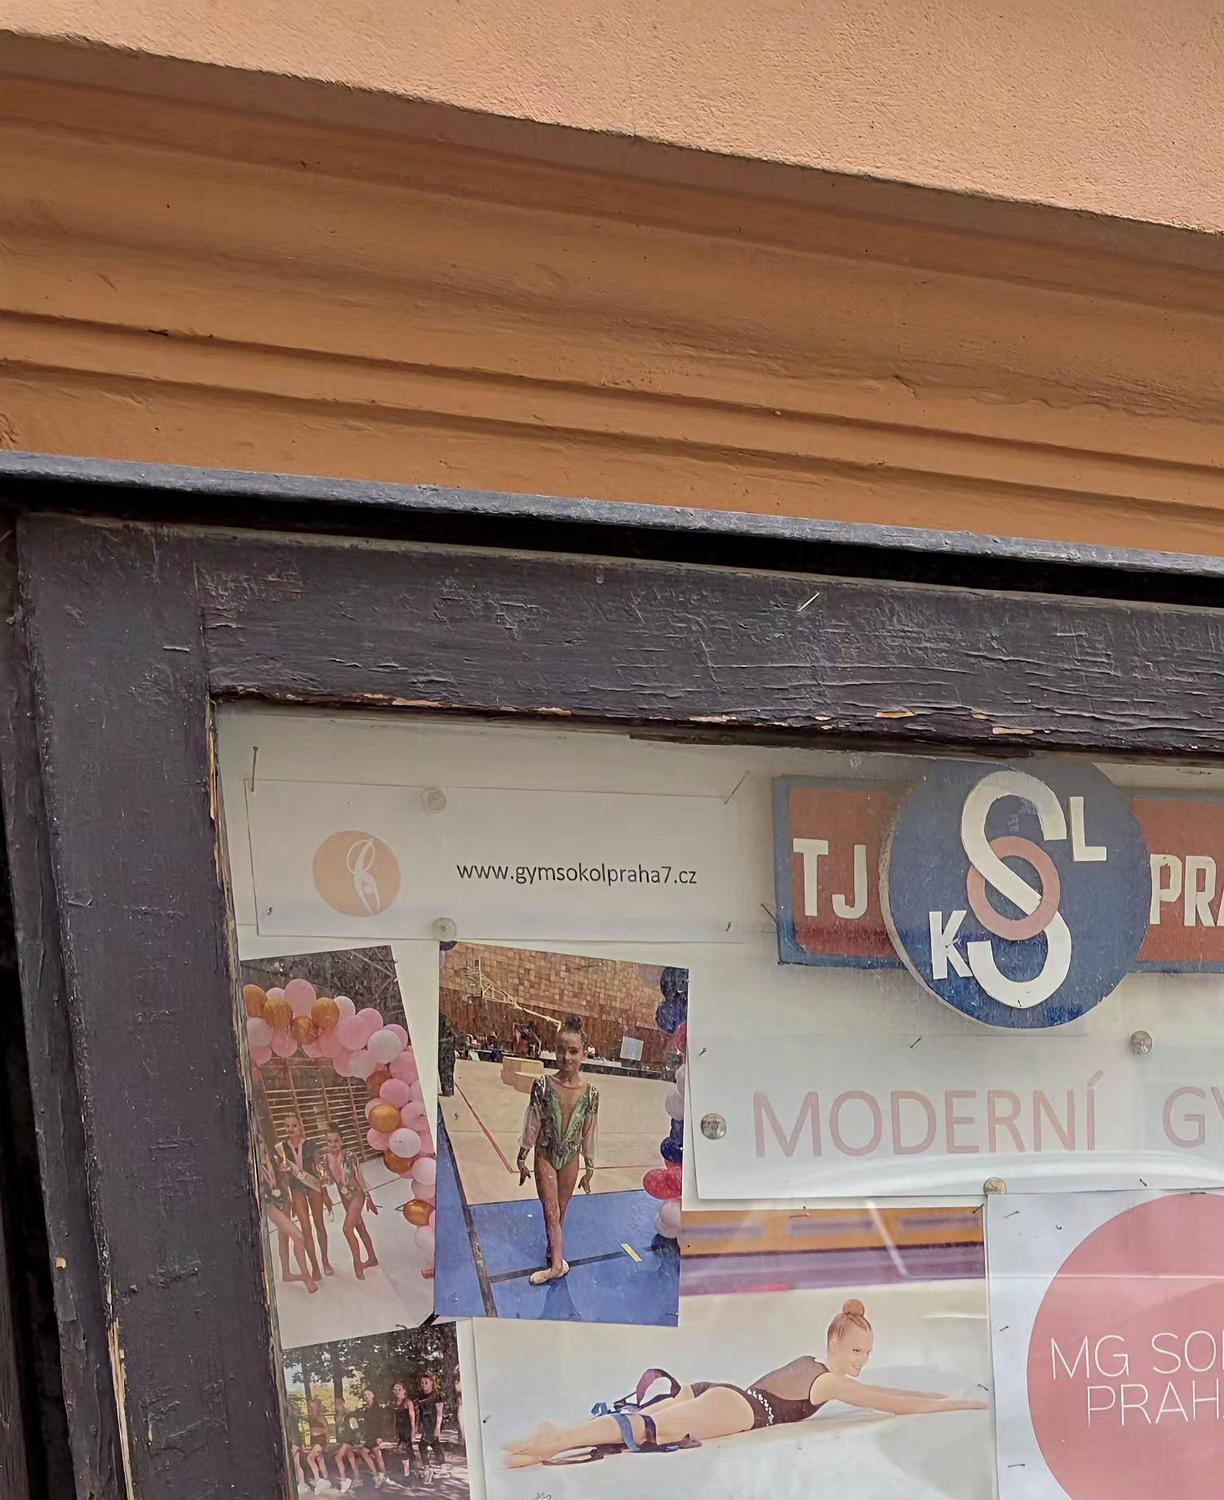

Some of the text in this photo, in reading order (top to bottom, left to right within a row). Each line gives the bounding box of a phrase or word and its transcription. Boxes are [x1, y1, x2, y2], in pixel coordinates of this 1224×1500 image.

[456, 863, 697, 886] www.gymsokolpraha7.cz
[793, 837, 868, 919] TJ
[753, 1071, 1104, 1158] MODERNÍ
[1050, 1335, 1130, 1380] MG
